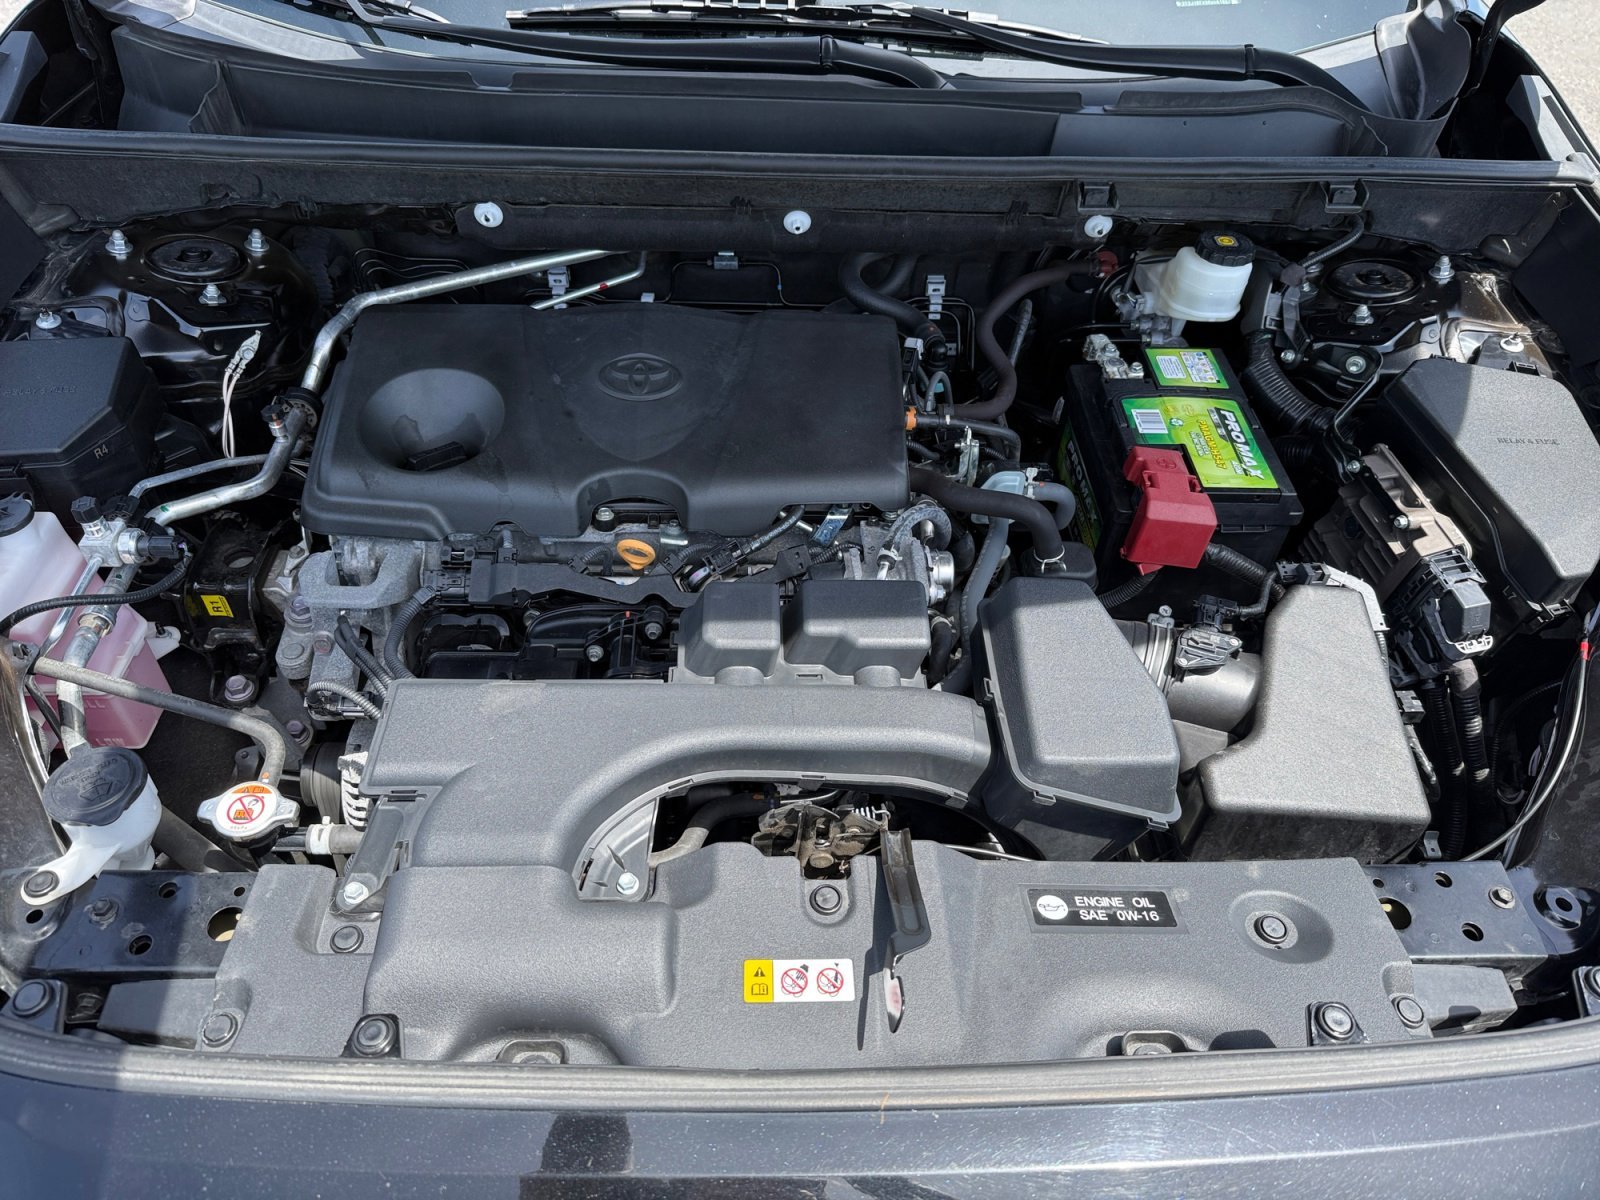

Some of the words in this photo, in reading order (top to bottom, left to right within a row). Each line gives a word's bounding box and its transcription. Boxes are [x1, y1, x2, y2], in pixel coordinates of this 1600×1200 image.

[94, 444, 109, 460] R4
[209, 600, 225, 613] R1
[1074, 896, 1125, 908] ENGINE
[1132, 897, 1156, 908] OIL
[1079, 909, 1109, 921] SAE
[1116, 910, 1160, 922] 0W-16
